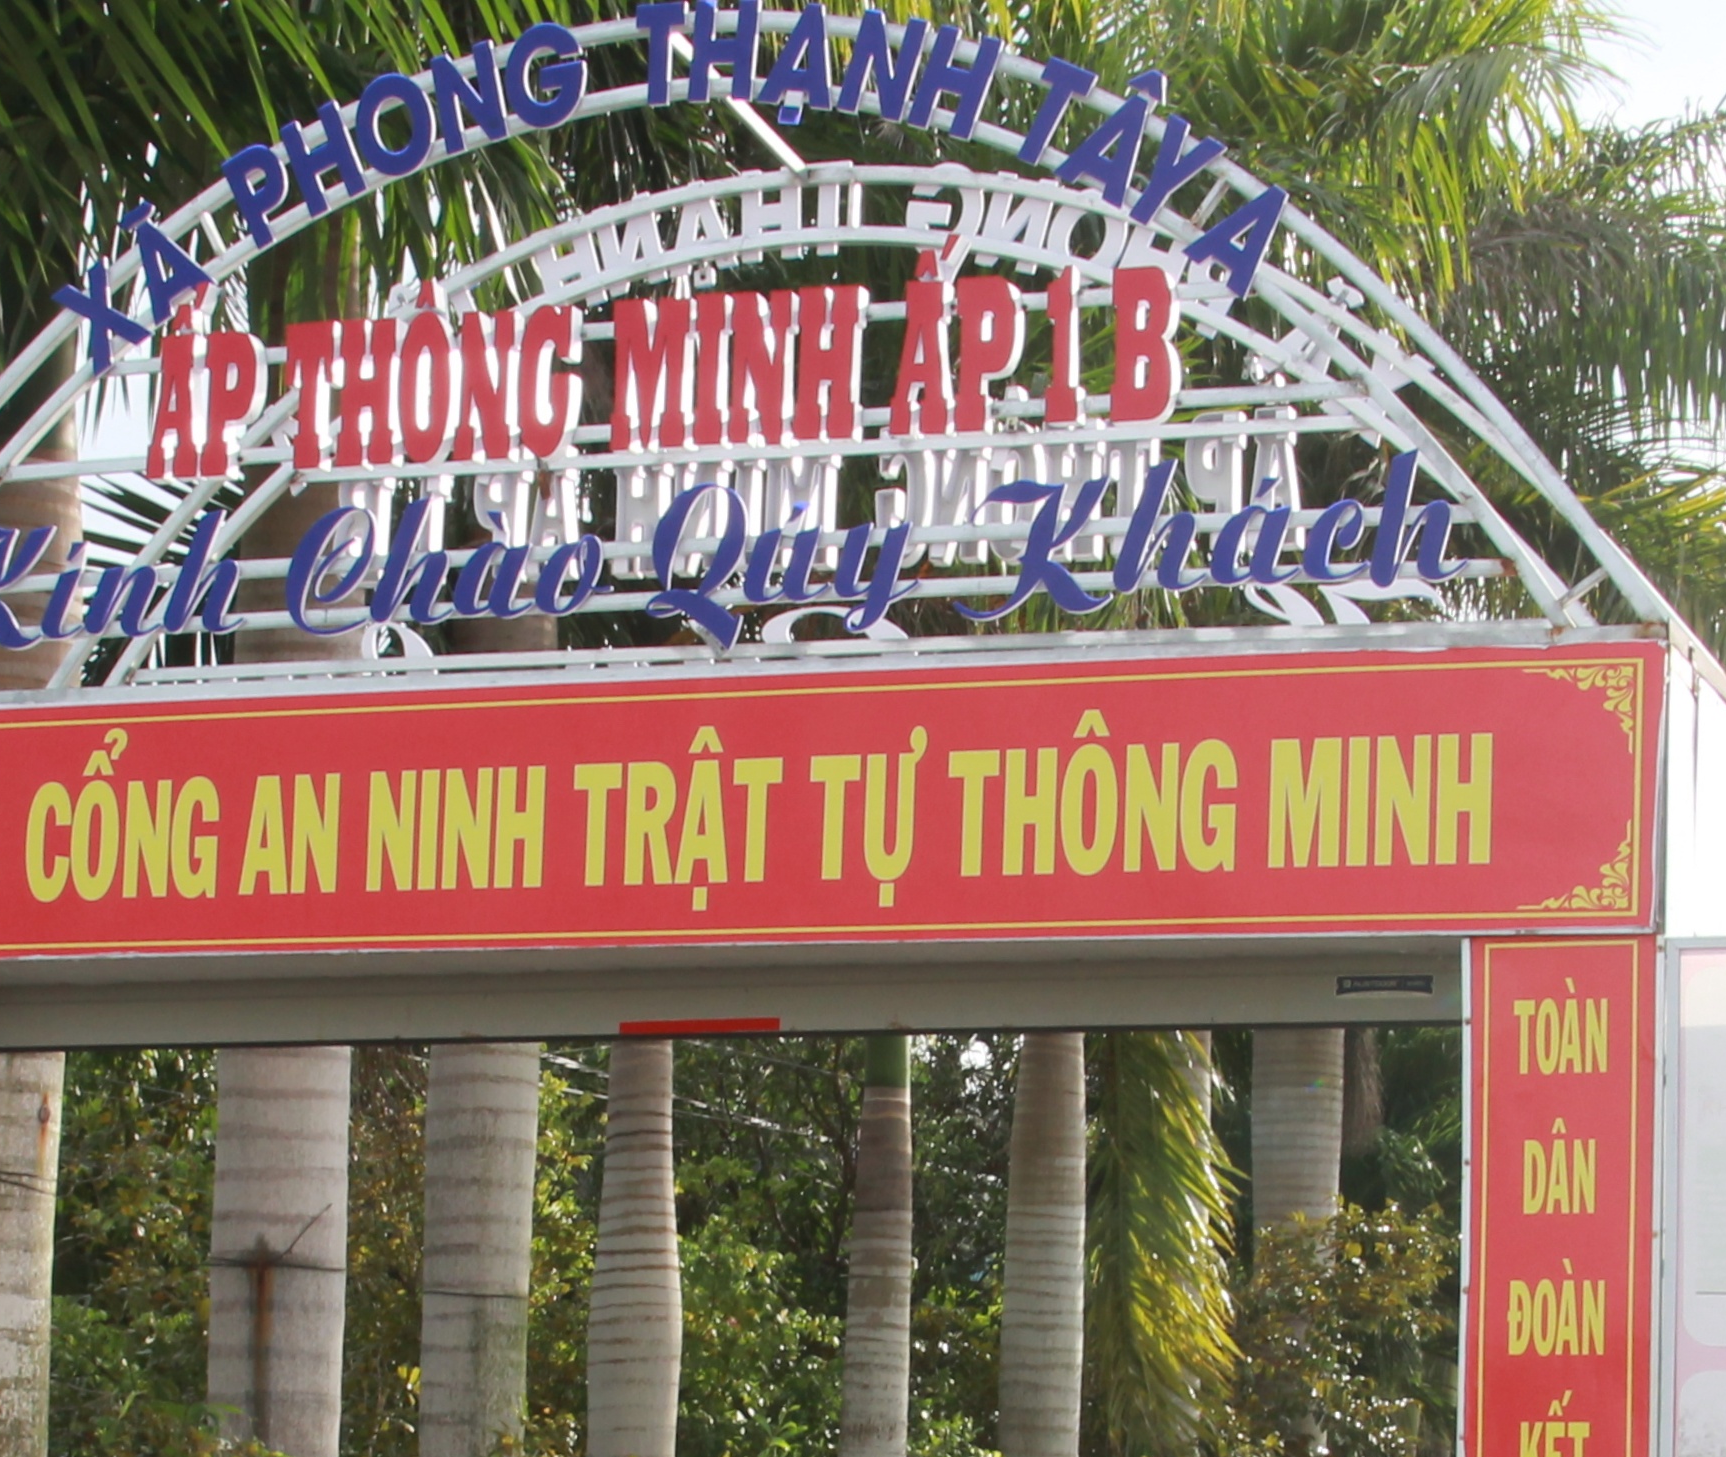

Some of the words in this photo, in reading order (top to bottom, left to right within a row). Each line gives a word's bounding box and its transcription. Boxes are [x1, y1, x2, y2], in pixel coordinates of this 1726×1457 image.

[52, 200, 218, 377] XÃ
[221, 22, 586, 248] PHONG
[635, 0, 1002, 138] THẠNH
[1018, 57, 1228, 226] TÂY
[1184, 185, 1288, 299] A
[146, 280, 260, 481] ẤP
[285, 279, 578, 472] THÔNG
[609, 282, 865, 452] MINH
[889, 234, 1025, 437] ẤP
[285, 497, 614, 635] Chào
[646, 481, 918, 649] Quý
[954, 450, 1465, 621] Khách
[24, 727, 221, 902] CỔNG
[238, 772, 342, 896] AN
[365, 765, 547, 893] NINH
[573, 725, 782, 912] TRẬT
[810, 725, 929, 909] TỰ
[948, 708, 1240, 878] THÔNG
[1267, 732, 1494, 869] MINH
[1513, 977, 1610, 1076] TOÀN
[1522, 1117, 1597, 1216] DÂN
[1506, 1258, 1607, 1358] ĐOÀN
